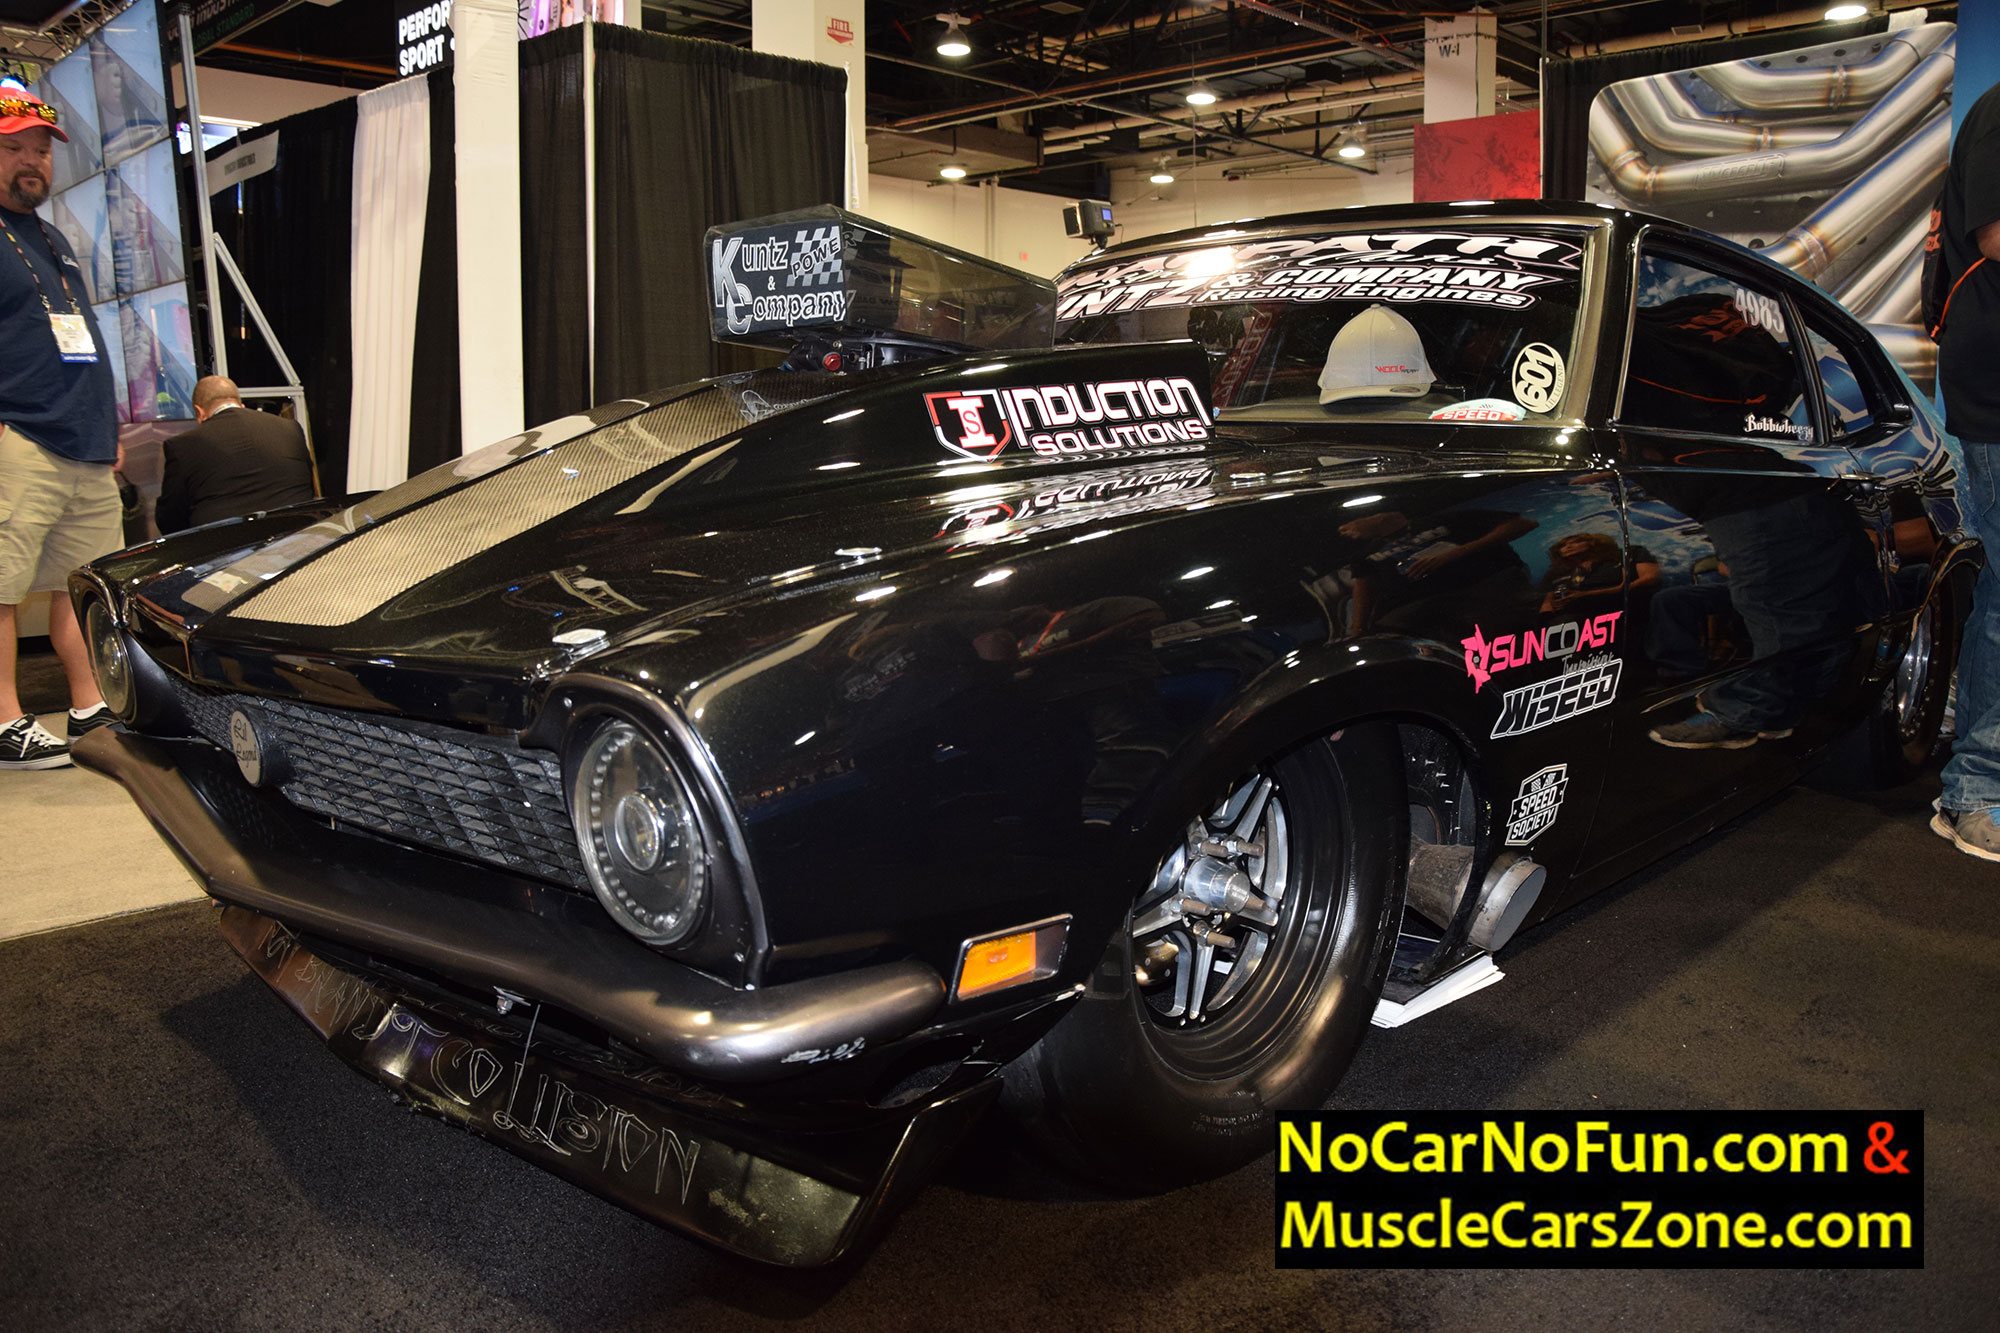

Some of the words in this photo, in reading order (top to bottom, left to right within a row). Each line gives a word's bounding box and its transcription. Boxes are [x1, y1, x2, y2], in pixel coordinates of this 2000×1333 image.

[399, 34, 445, 76] SPORT
[712, 237, 789, 308] Kuntz
[791, 231, 856, 279] POWER
[767, 275, 776, 291] &
[1211, 273, 1254, 288] &
[1262, 267, 1544, 292] COMPANY
[727, 282, 853, 335] Company
[1197, 284, 1333, 302] Racing
[1342, 283, 1529, 306] Engines
[1735, 288, 1784, 334] 4983
[1000, 377, 1212, 447] INDUCTION
[1443, 411, 1502, 421] SPEED
[1030, 419, 1209, 456] SOLUTIONS
[1490, 611, 1625, 673] SUNCOAST
[1518, 786, 1558, 818] SPEED
[1511, 807, 1555, 839] SOCIETY
